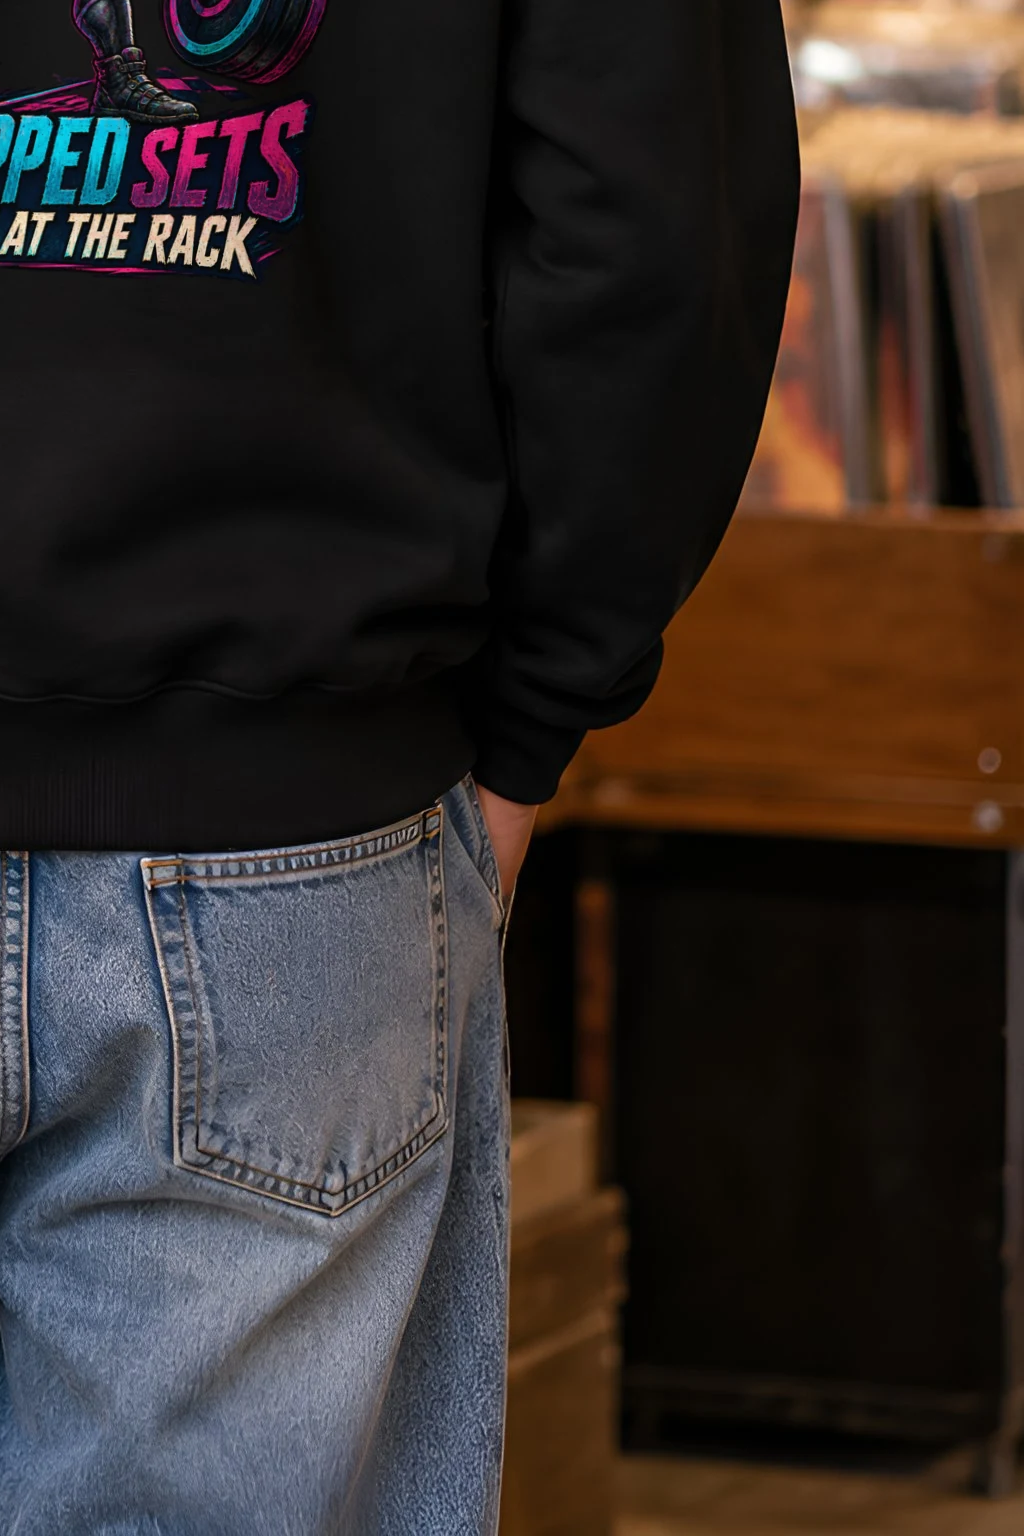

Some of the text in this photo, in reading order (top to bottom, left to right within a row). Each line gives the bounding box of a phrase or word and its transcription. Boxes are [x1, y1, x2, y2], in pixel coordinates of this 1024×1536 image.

[130, 98, 312, 223] SETS
[3, 211, 55, 256] AT
[67, 212, 134, 261] THE
[141, 213, 259, 280] RACK
